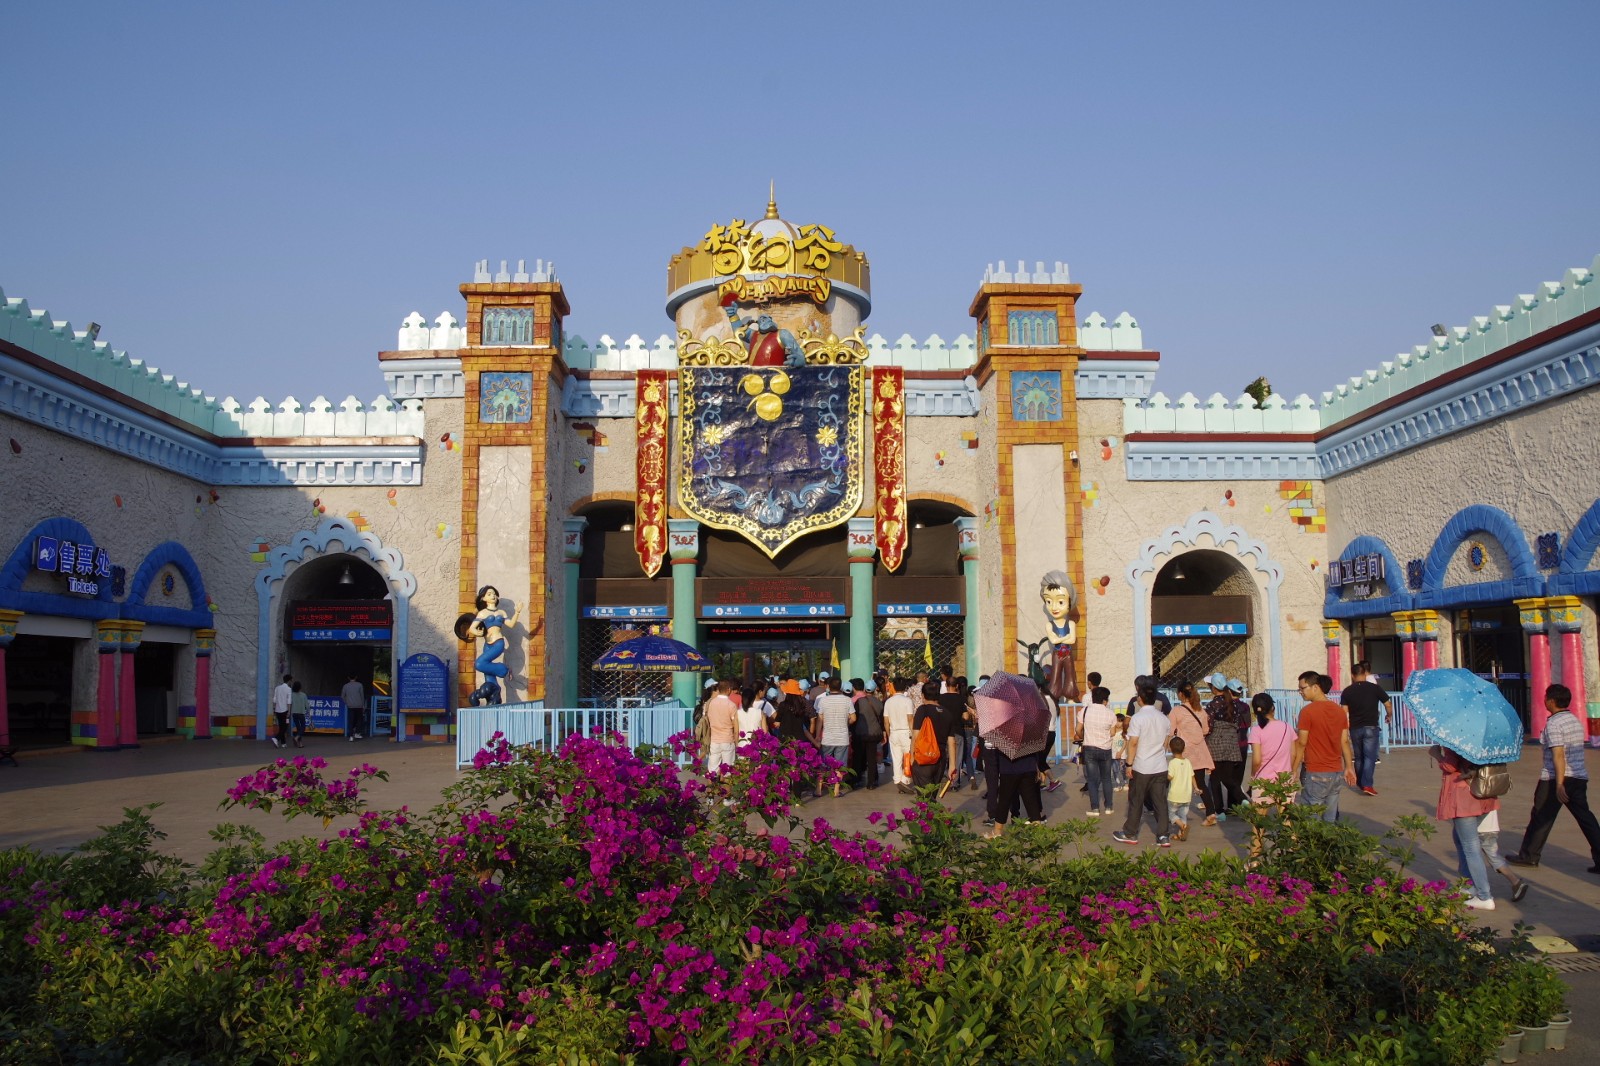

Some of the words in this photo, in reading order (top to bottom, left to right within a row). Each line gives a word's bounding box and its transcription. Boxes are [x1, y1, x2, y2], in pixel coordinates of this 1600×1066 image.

[59, 541, 111, 577] 售票处
[1342, 554, 1380, 584] 卫生间
[68, 577, 98, 594] Tickets
[1353, 584, 1370, 595] Toilet
